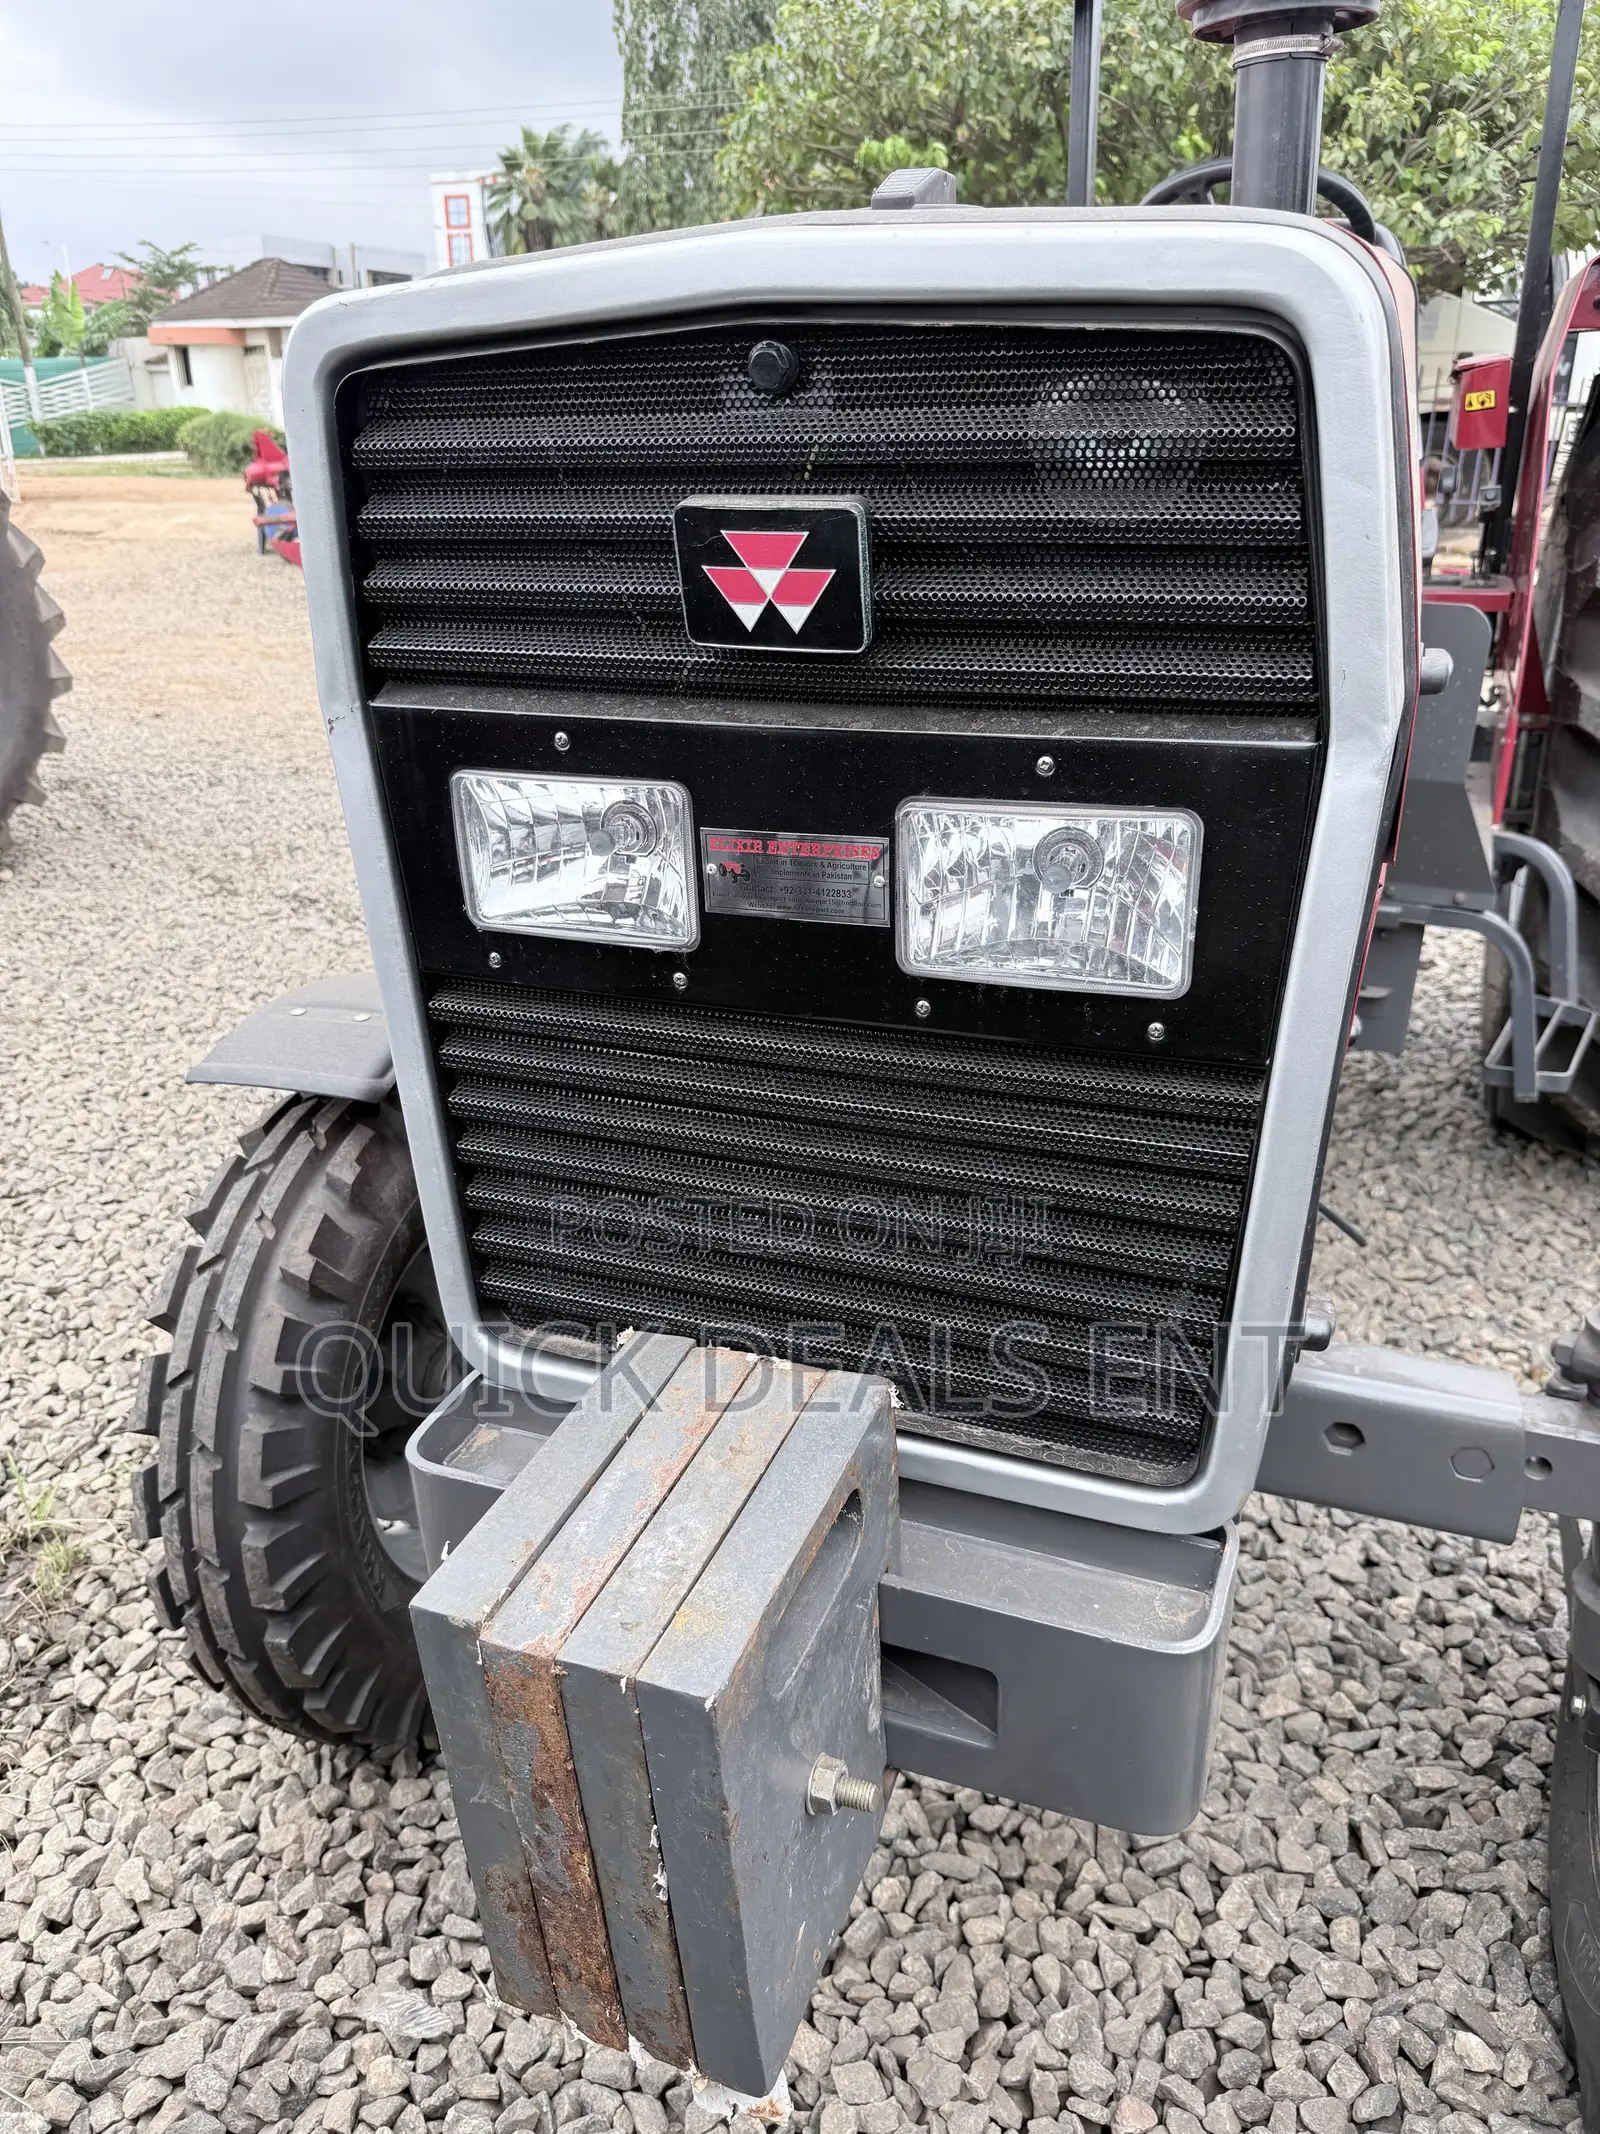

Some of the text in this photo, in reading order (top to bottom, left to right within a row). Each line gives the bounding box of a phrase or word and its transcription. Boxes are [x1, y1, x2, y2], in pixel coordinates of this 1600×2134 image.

[708, 837, 881, 860] ELIXIR ENTERPRISES
[789, 860, 818, 868] Tractors
[819, 861, 826, 869] &
[827, 862, 867, 871] Agriculture
[770, 868, 810, 877] Implements
[821, 871, 852, 880] Pakistan
[740, 883, 776, 893] Contact:
[779, 886, 852, 898] +92-331-4122833
